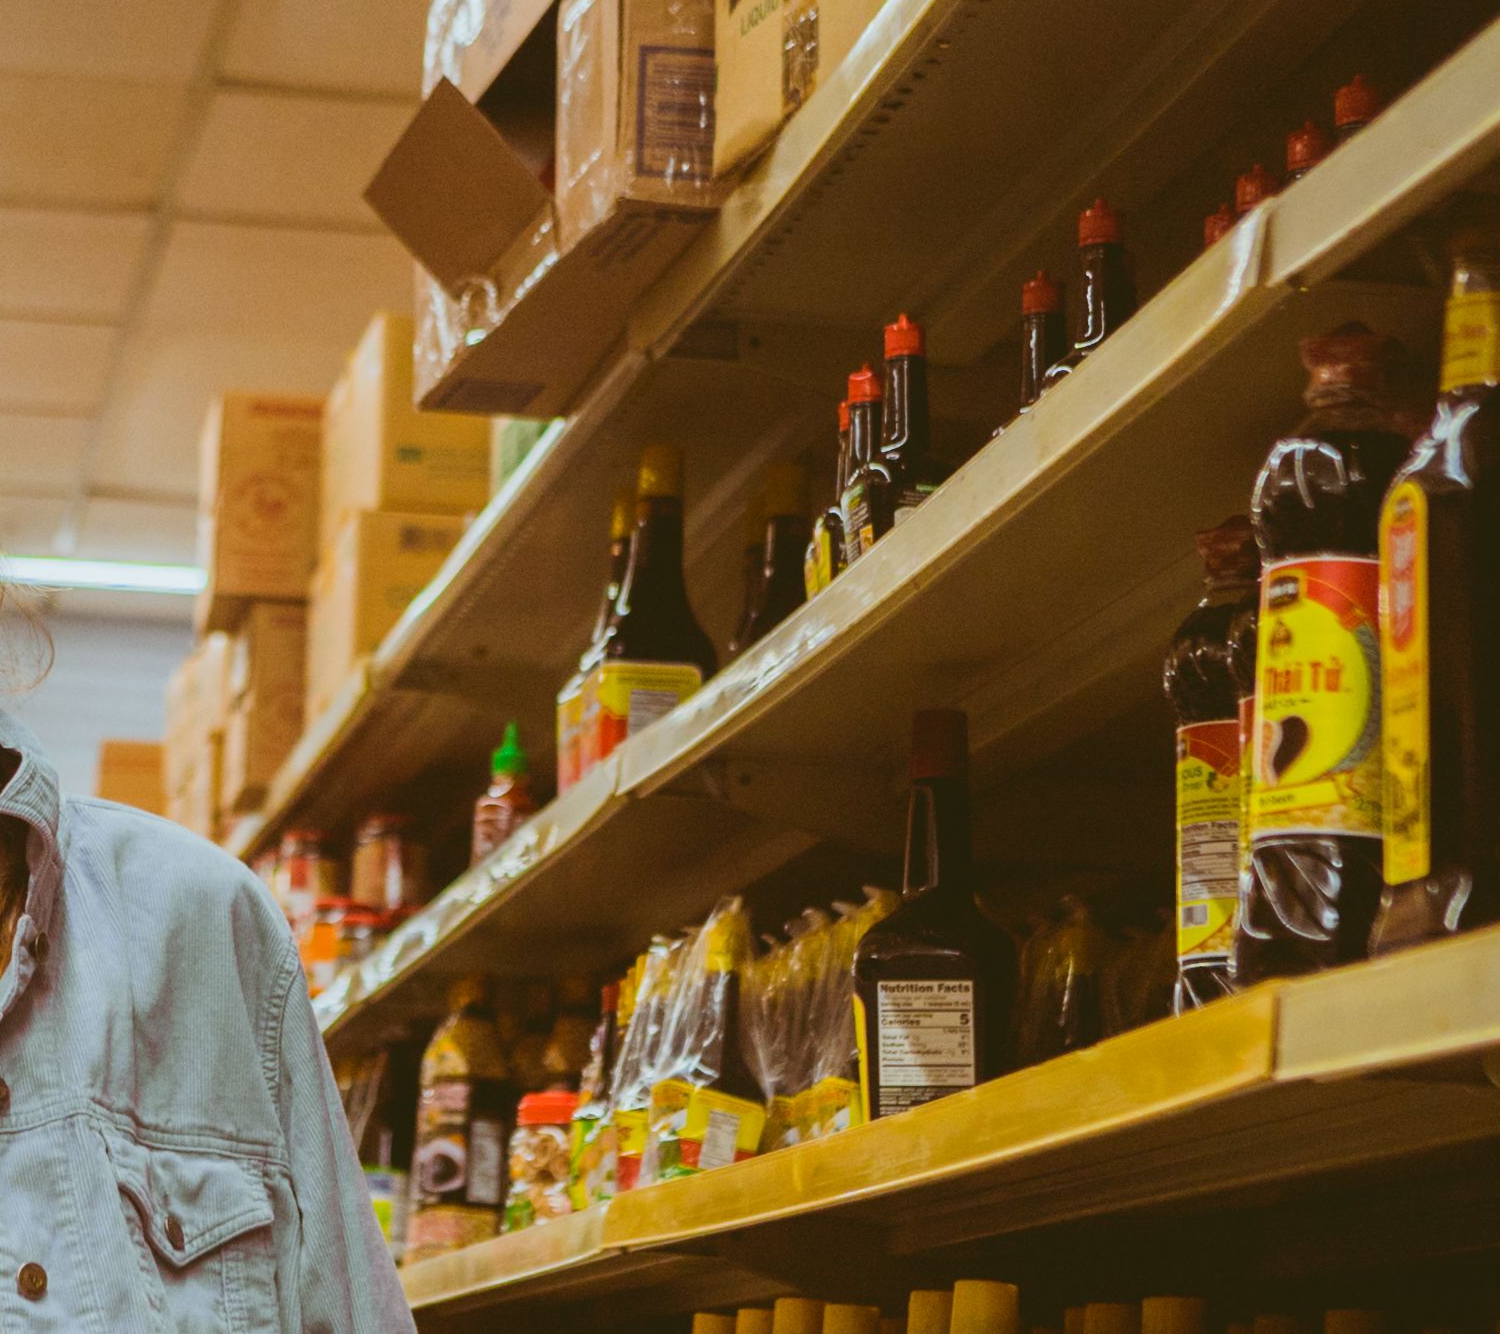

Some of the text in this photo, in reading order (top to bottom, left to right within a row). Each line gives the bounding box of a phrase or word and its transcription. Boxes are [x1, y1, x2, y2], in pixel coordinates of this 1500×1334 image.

[880, 983, 971, 994] Nutrition Facts
[881, 1013, 970, 1027] Calories 5
